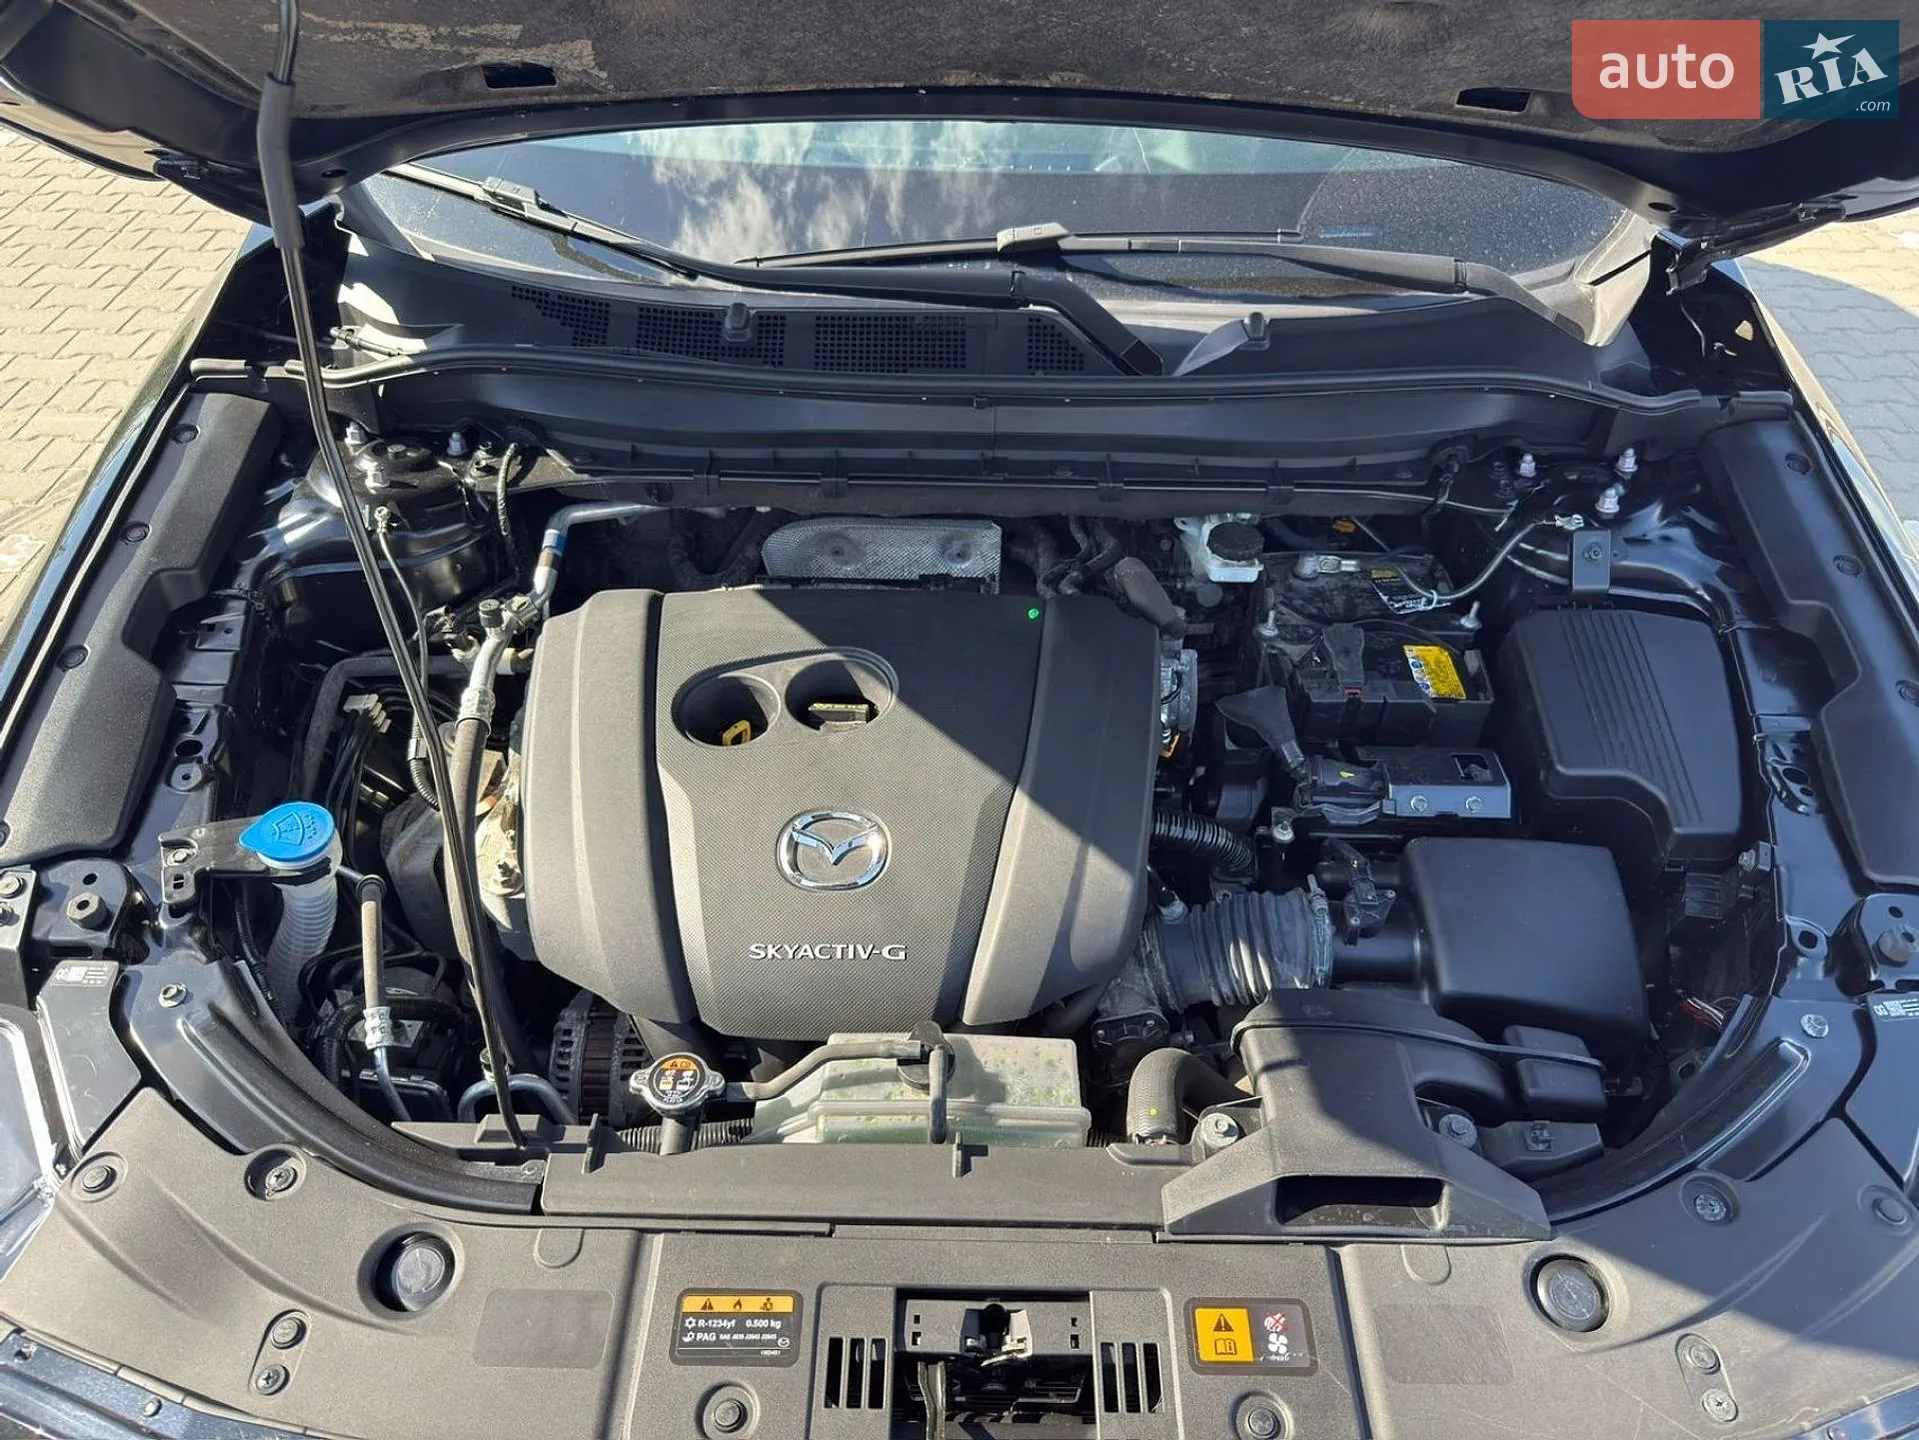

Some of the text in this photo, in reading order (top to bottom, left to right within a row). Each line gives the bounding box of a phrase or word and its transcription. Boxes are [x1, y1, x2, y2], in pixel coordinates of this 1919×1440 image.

[749, 943, 908, 961] SKYACTIV-G
[697, 1318, 782, 1330] R-1234yf 0.500 kg
[696, 1332, 716, 1342] PAG
